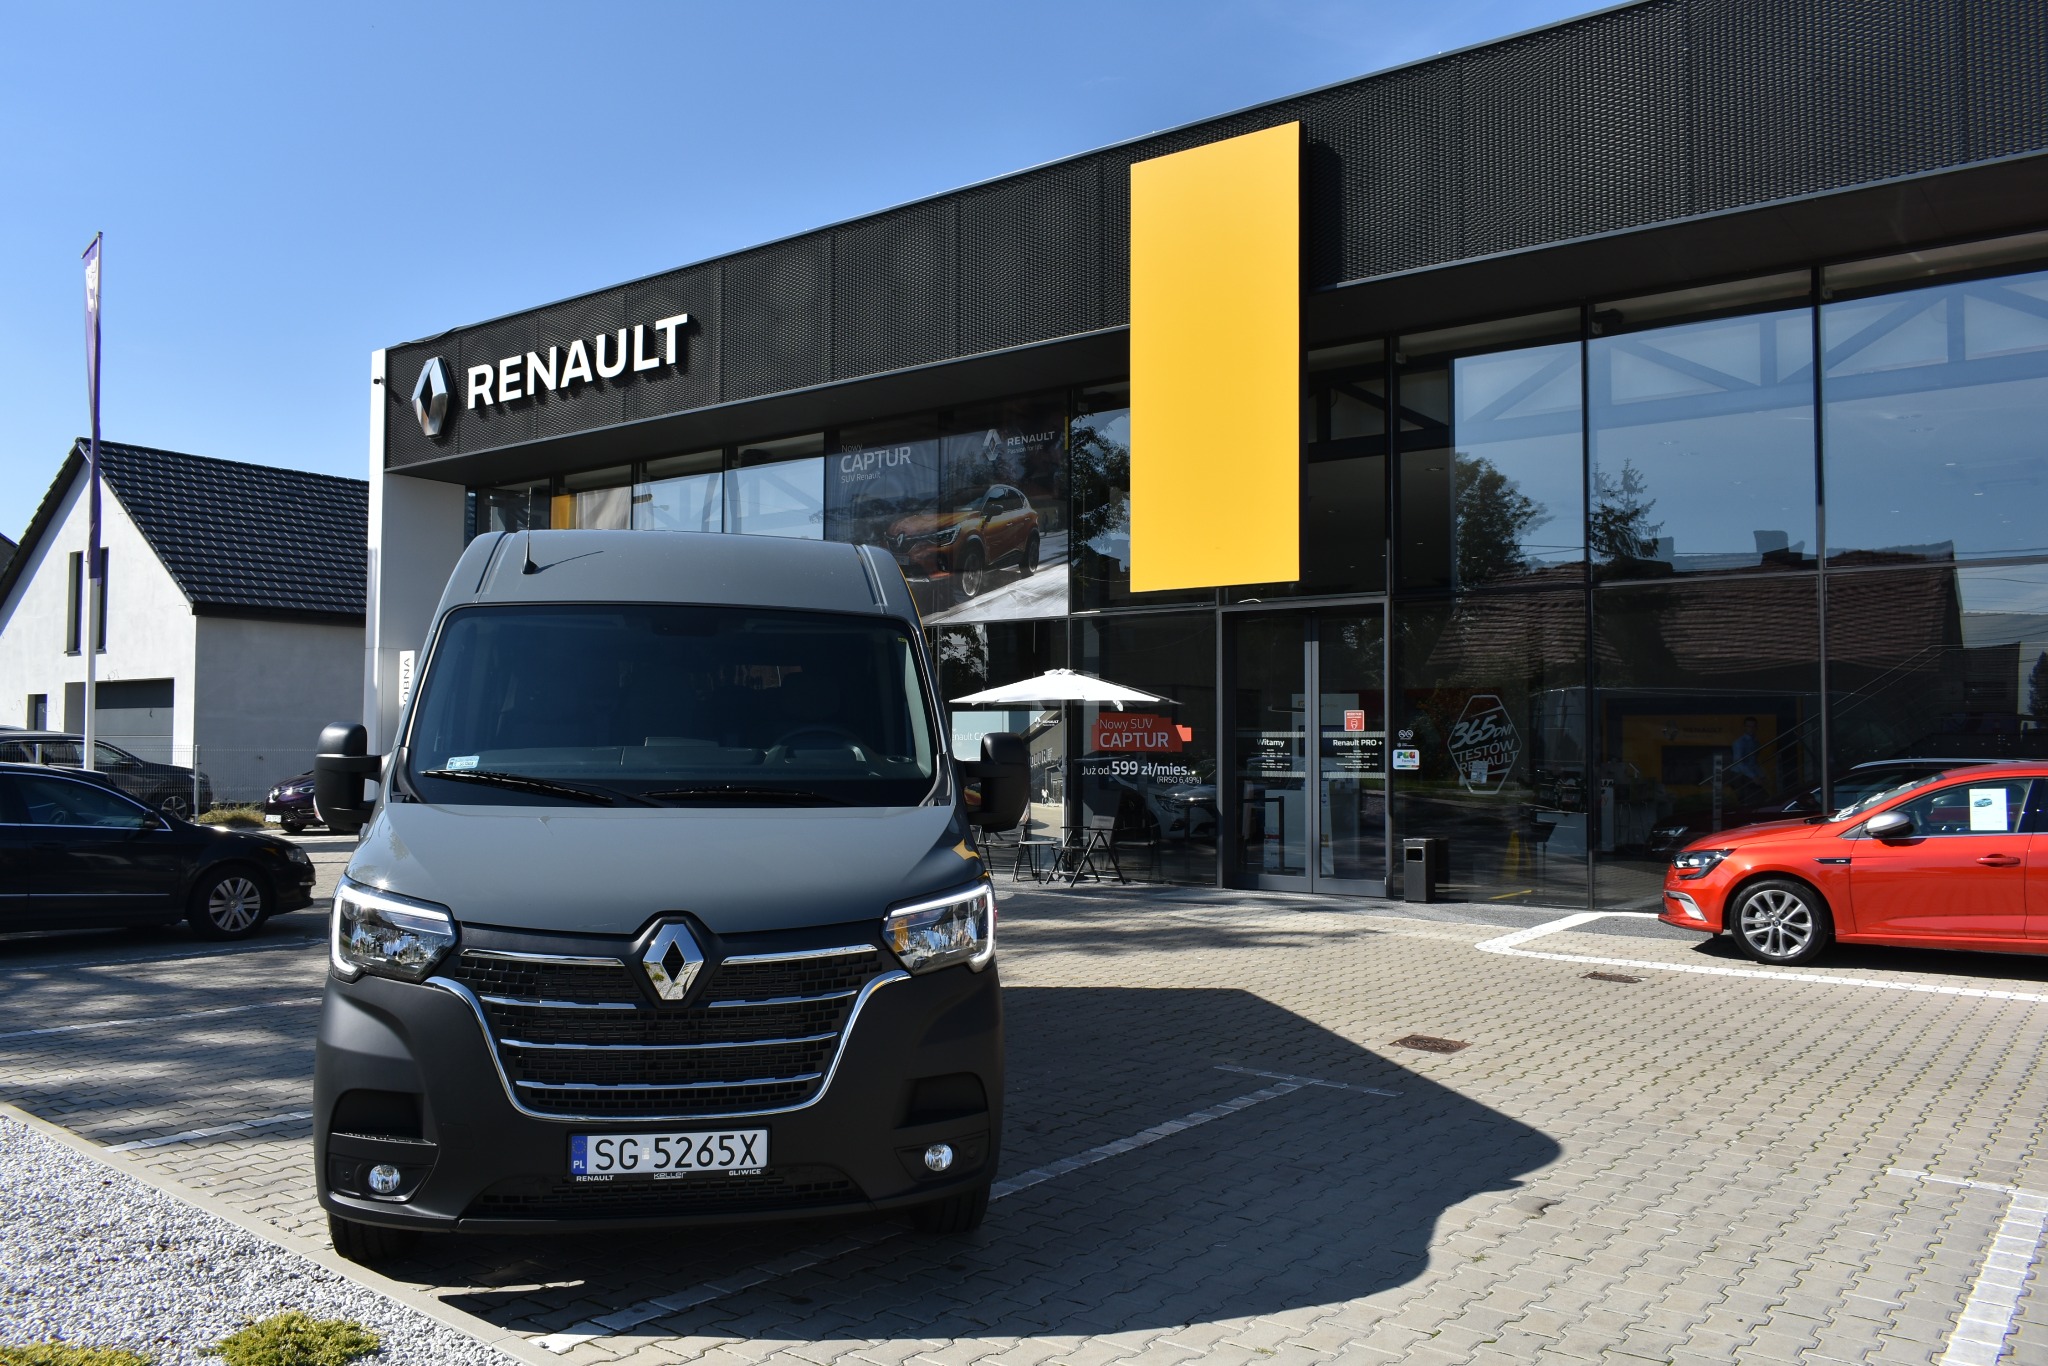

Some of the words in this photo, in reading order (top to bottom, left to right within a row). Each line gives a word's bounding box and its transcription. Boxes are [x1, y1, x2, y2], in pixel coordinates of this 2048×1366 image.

[467, 313, 687, 409] RENAULT
[1007, 431, 1055, 446] RENAULT
[840, 446, 911, 473] CAPTUR
[841, 475, 855, 483] SUV
[1100, 720, 1128, 731] Nowy
[1130, 719, 1153, 729] SUV
[1451, 715, 1497, 749] 365
[1493, 724, 1512, 738] DNI
[1100, 732, 1169, 748] CAPTUR
[1256, 739, 1285, 748] Witamy
[1459, 739, 1515, 761] TESTÓW
[1082, 766, 1096, 775] Już
[1097, 766, 1109, 775] od
[1111, 761, 1138, 775] 599
[1141, 763, 1191, 777] zł/mies.
[595, 1138, 639, 1171] SG
[653, 1133, 758, 1169] 5265X
[573, 1160, 585, 1169] PL
[576, 1174, 615, 1182] RENAULT
